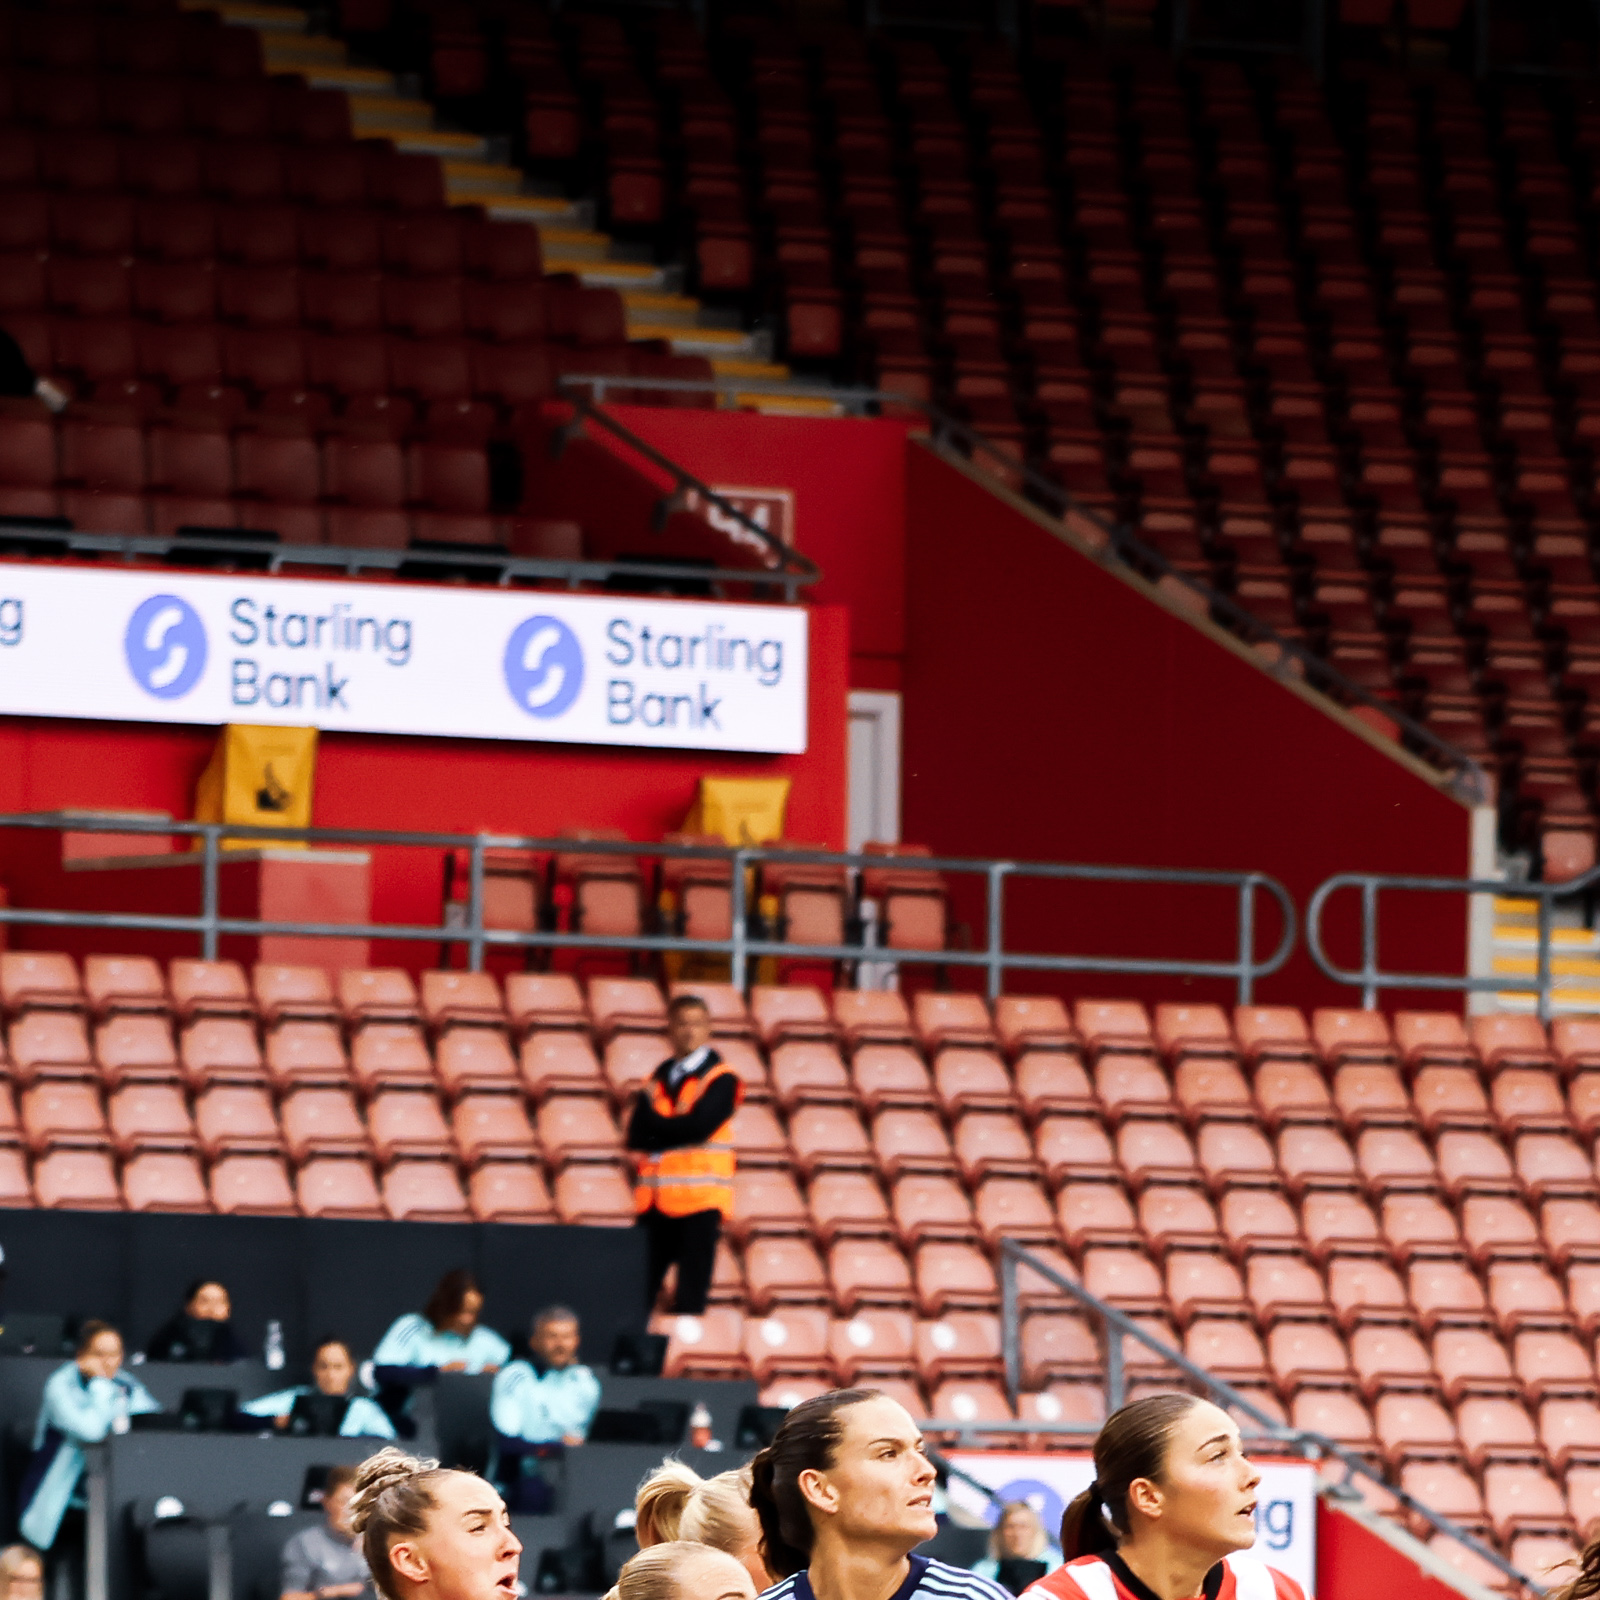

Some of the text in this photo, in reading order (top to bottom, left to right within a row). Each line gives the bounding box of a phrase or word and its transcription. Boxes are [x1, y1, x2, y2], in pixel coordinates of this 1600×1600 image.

[230, 597, 413, 666] Starling
[606, 618, 783, 687] Starling
[231, 659, 350, 710] Bank
[608, 679, 724, 730] Bank
